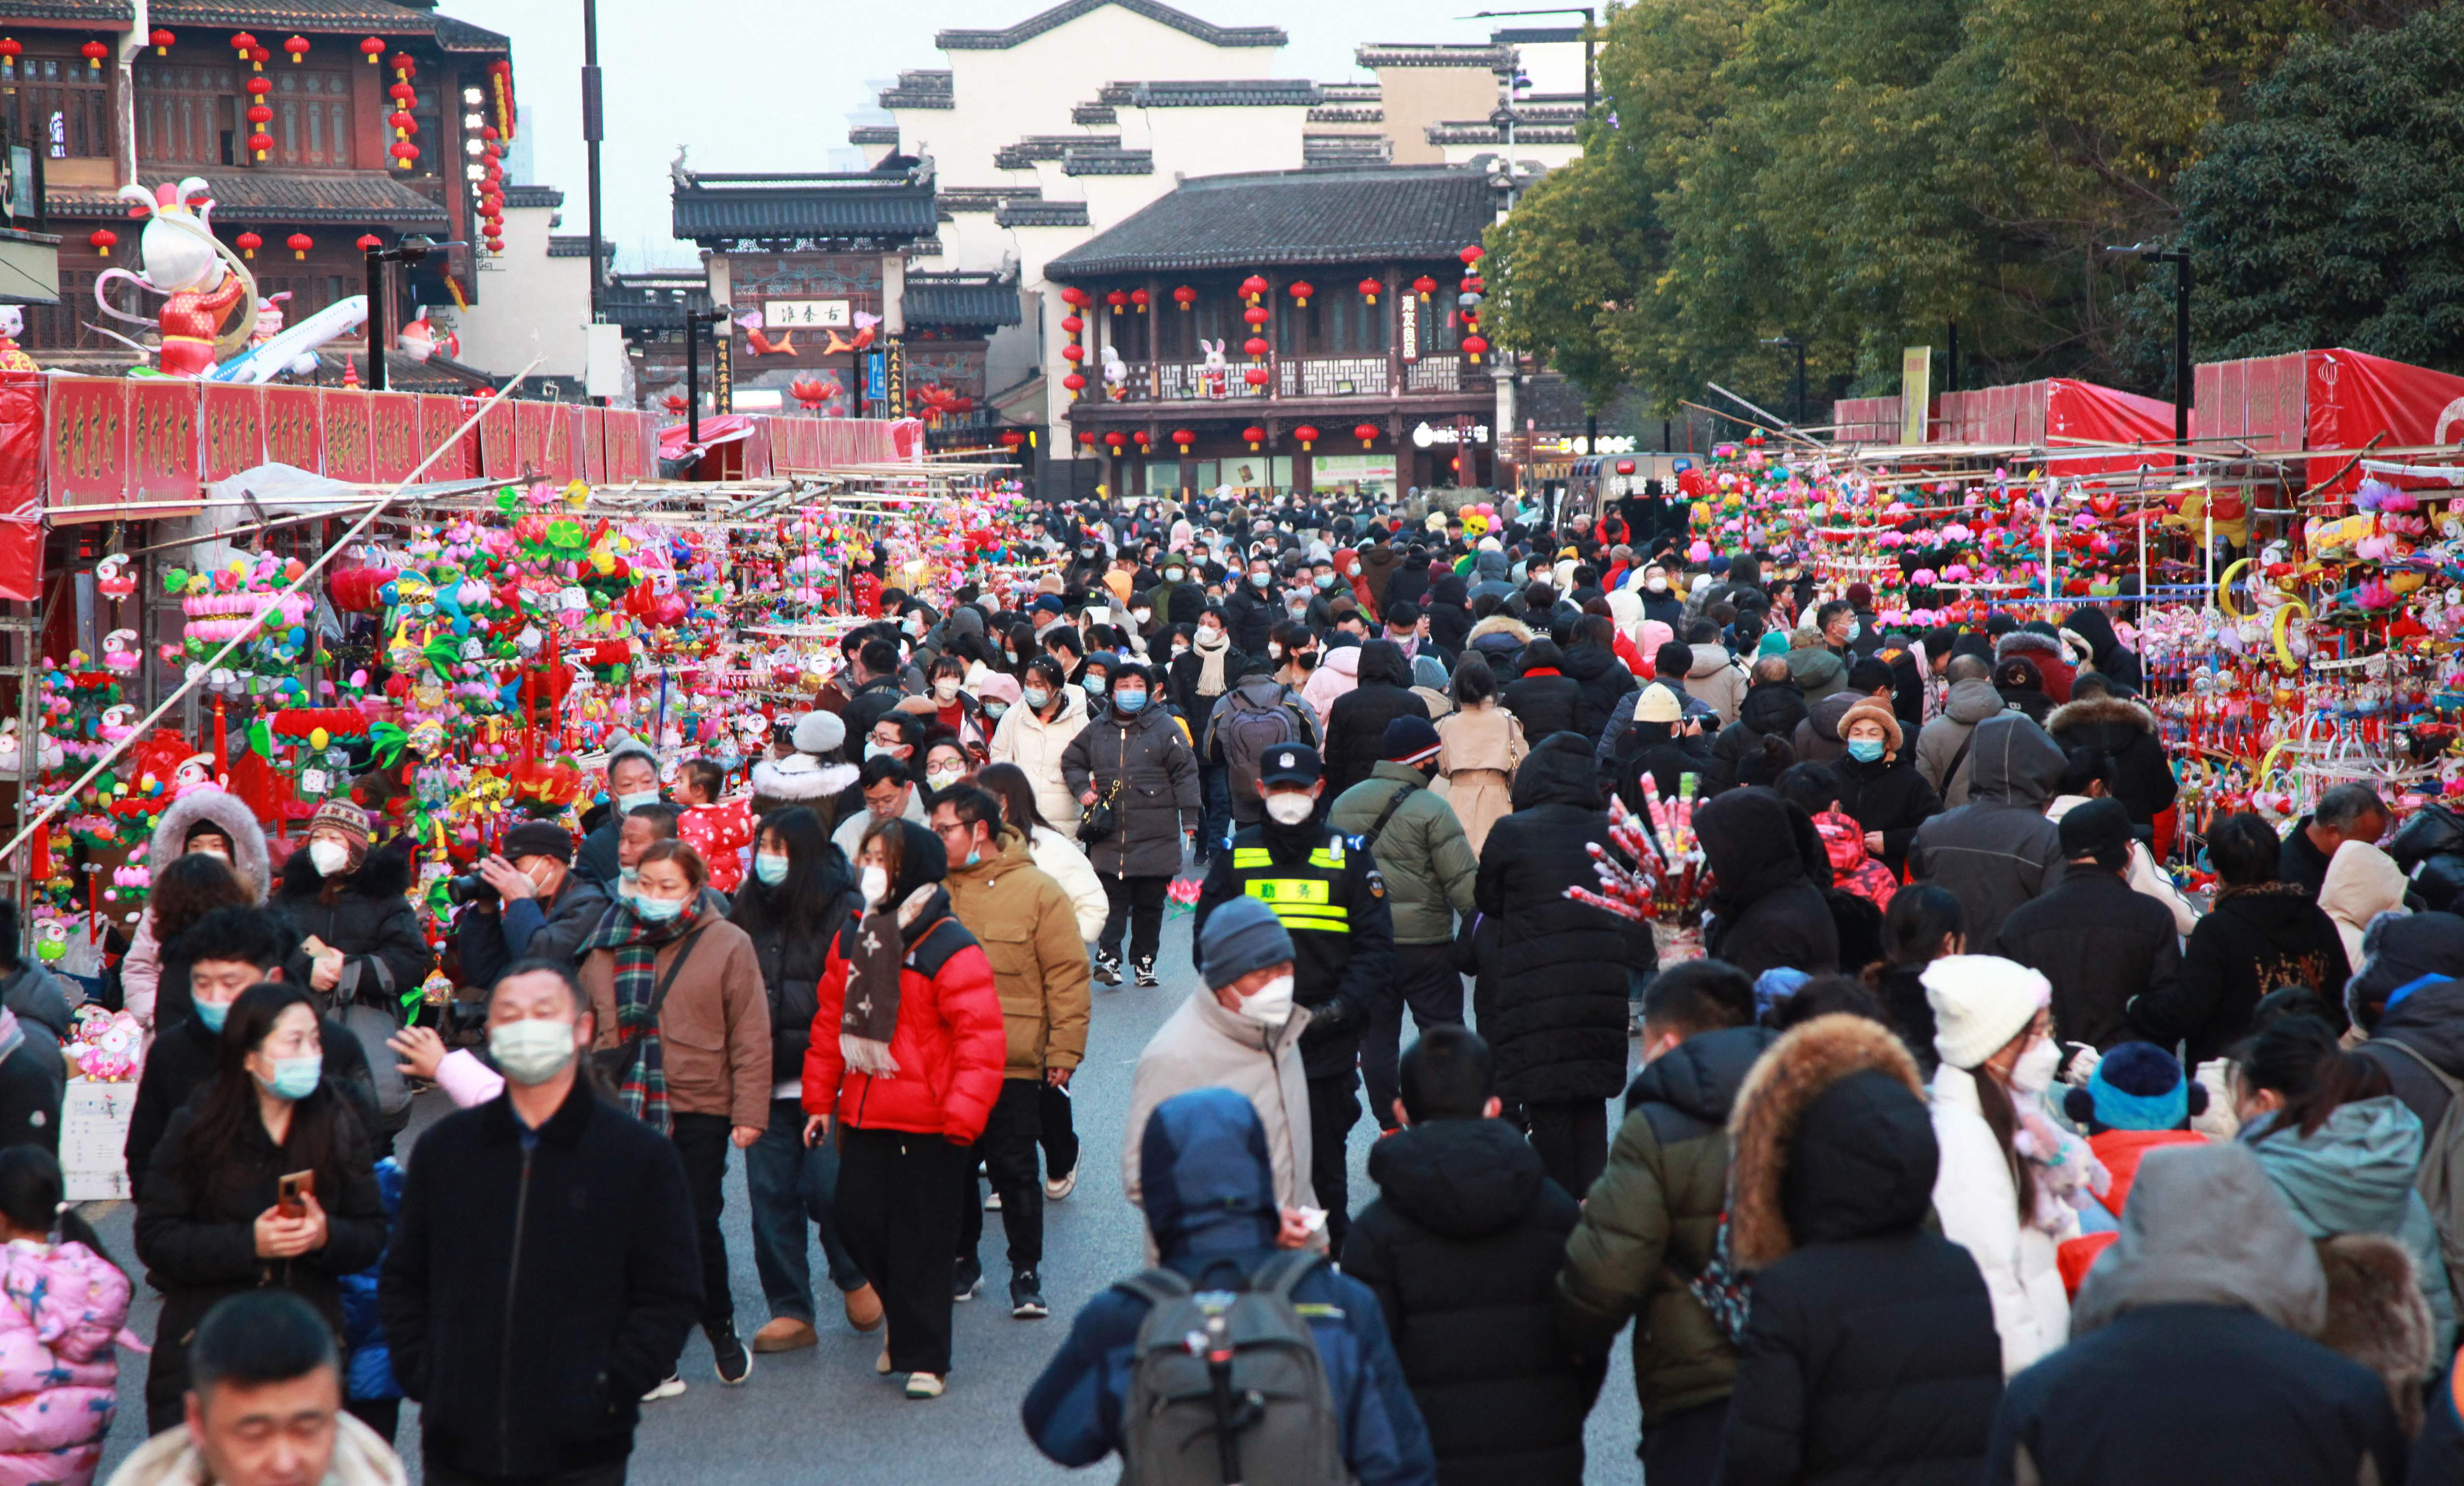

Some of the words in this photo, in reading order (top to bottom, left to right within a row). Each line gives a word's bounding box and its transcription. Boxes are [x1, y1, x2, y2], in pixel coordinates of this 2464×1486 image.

[782, 304, 841, 322] 古秦淮
[1403, 295, 1416, 359] 海友良品
[1609, 476, 1646, 495] 特警
[1661, 475, 1678, 494] 排
[1261, 883, 1310, 899] 勤务
